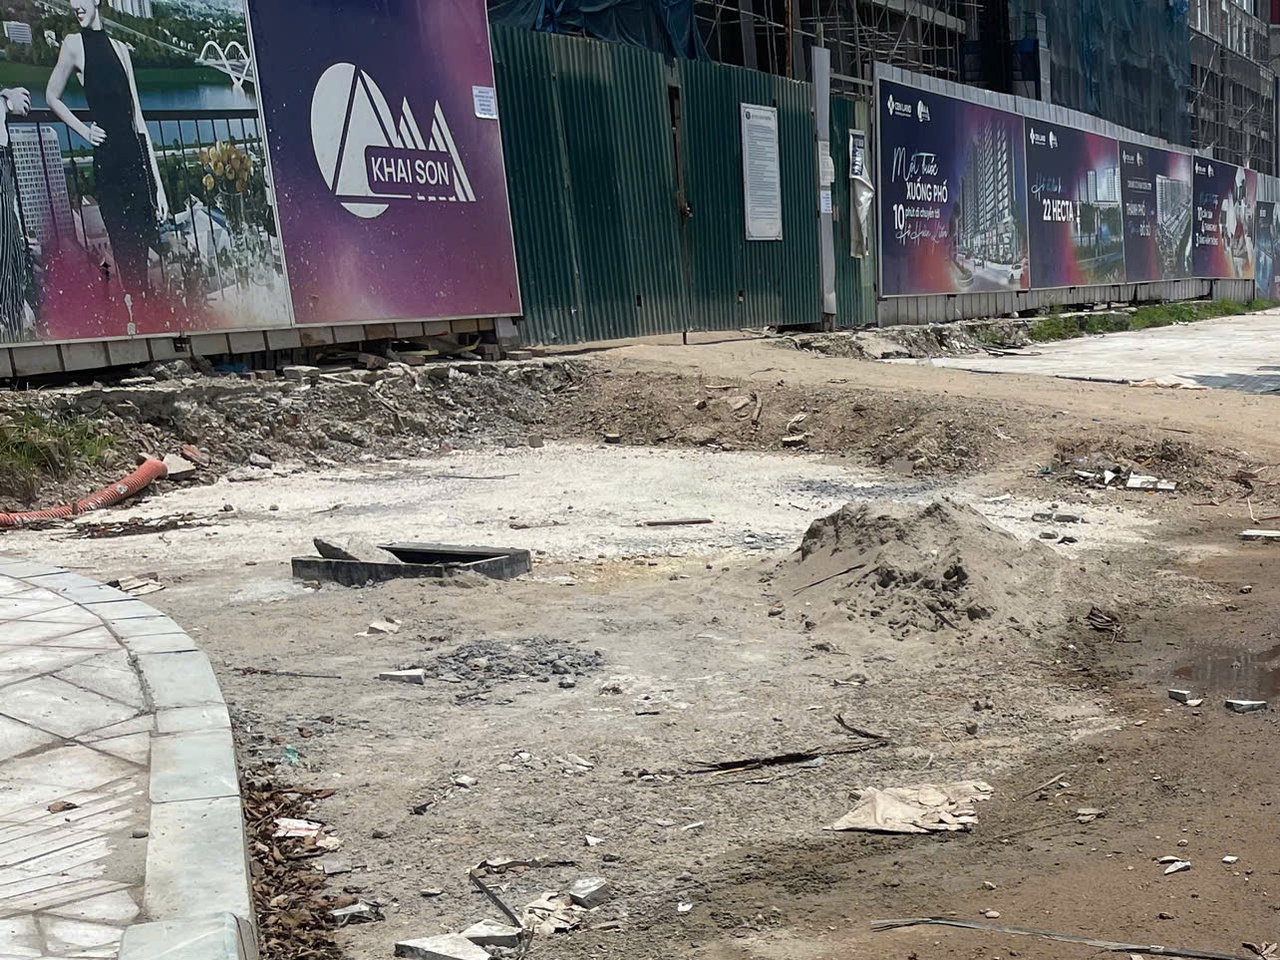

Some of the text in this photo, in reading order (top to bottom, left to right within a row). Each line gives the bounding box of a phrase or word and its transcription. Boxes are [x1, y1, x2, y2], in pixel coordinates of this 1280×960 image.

[371, 156, 450, 185] KHAI SON
[906, 176, 948, 203] XUỐNG PHỐ
[893, 203, 905, 230] 10
[1042, 198, 1074, 222] 22 HECTA
